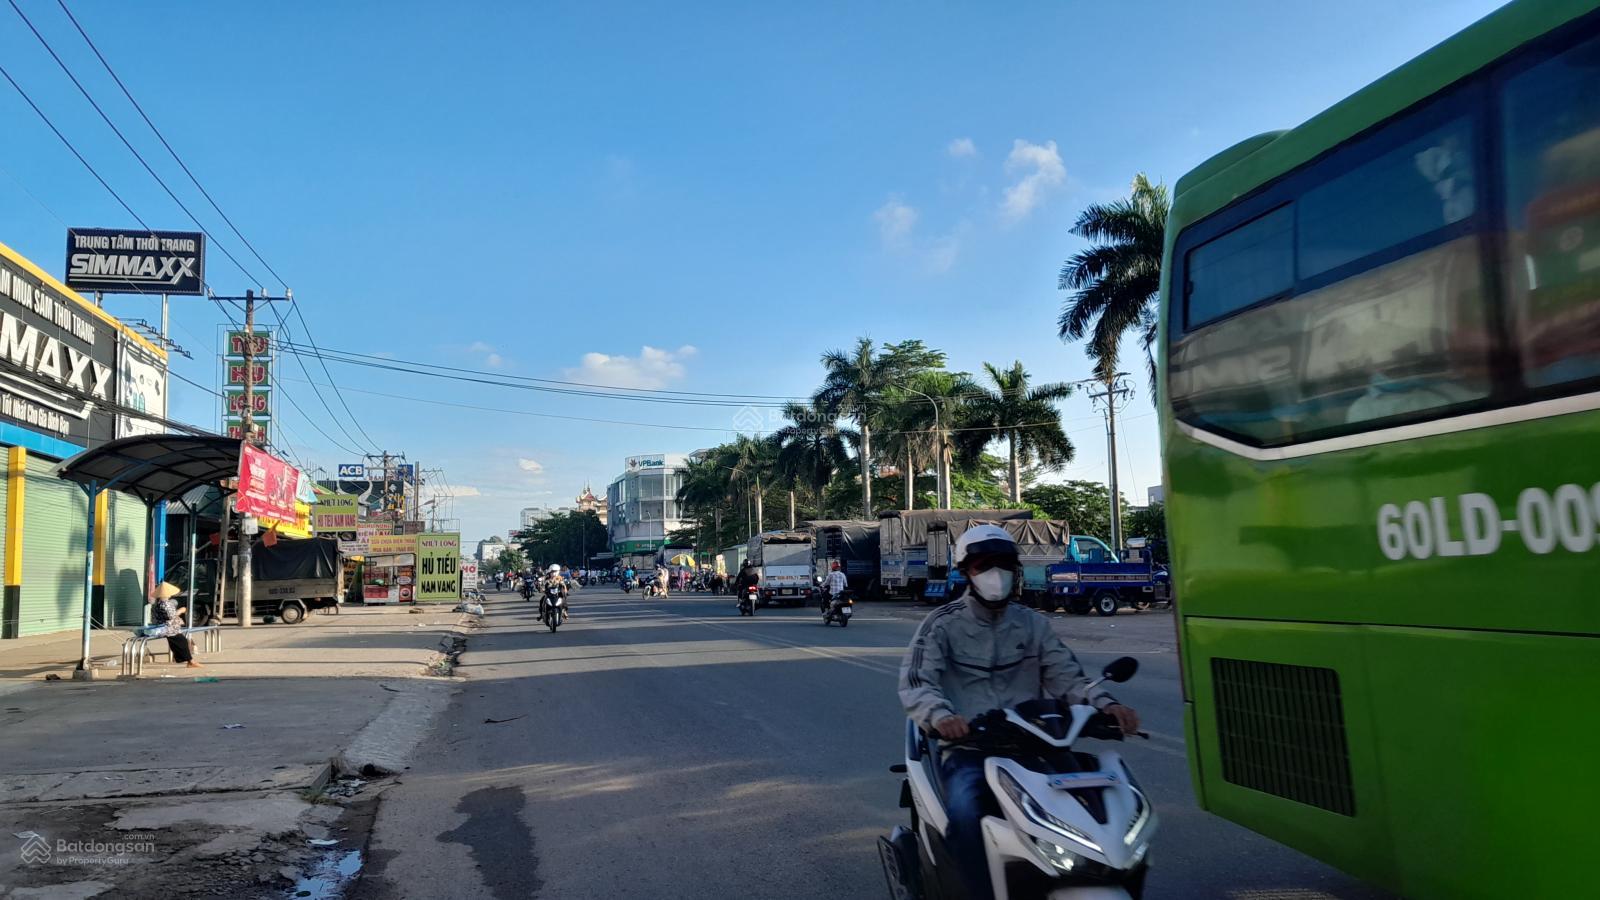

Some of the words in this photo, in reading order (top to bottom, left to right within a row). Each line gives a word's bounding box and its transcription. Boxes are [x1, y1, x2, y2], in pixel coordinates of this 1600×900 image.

[74, 235, 109, 249] TRUNG
[111, 234, 133, 250] TÂM
[161, 238, 195, 252] TRANG
[69, 253, 195, 283] SIMMAXX
[12, 275, 33, 309] MUA
[72, 313, 95, 345] TRANG
[27, 404, 38, 425] Cho
[339, 466, 363, 475] ACB
[638, 459, 664, 467] VPBank
[440, 539, 457, 547] LONG
[422, 552, 434, 575] HỦ
[436, 551, 456, 575] TIẾU
[420, 580, 437, 594] NAM
[437, 580, 456, 594] VANG
